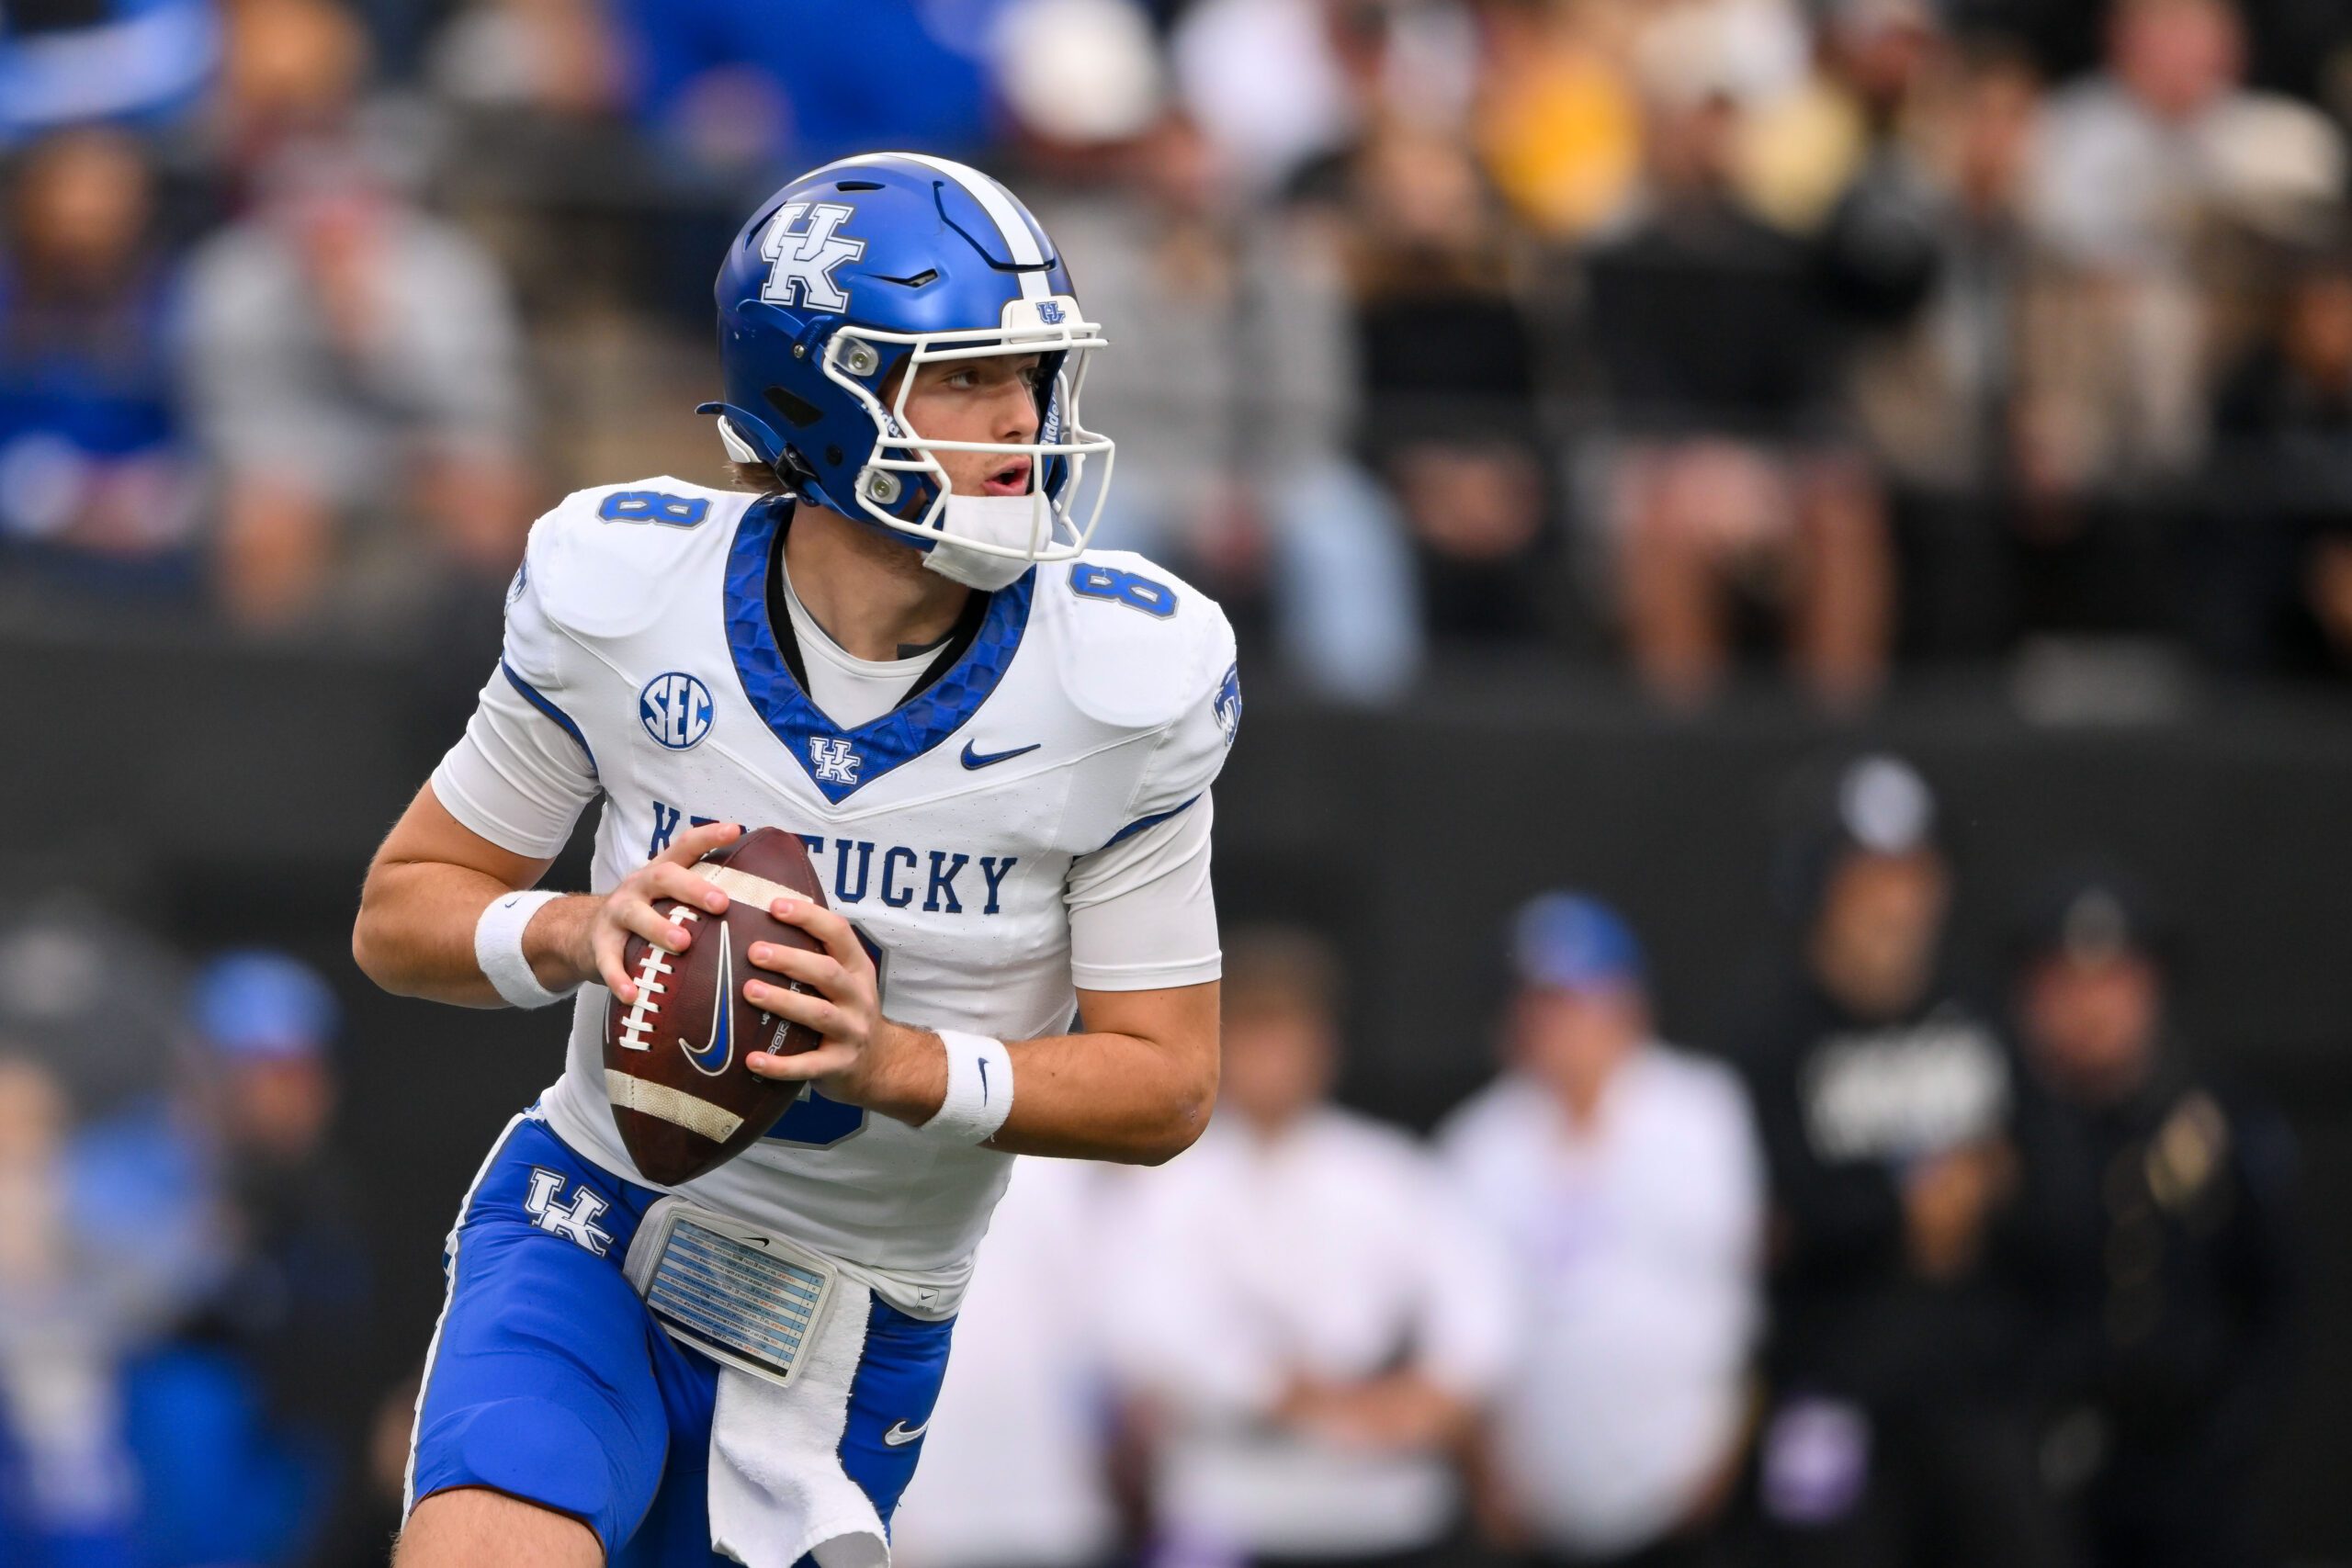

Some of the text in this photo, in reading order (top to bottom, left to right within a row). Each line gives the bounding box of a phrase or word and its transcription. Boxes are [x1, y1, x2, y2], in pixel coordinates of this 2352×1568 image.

[760, 202, 865, 314] UK
[595, 491, 714, 530] 8
[1066, 561, 1180, 621] 8
[642, 674, 711, 745] SEC
[809, 737, 860, 784] UK
[648, 801, 1017, 915] KUCKY
[525, 1168, 614, 1258] UK
